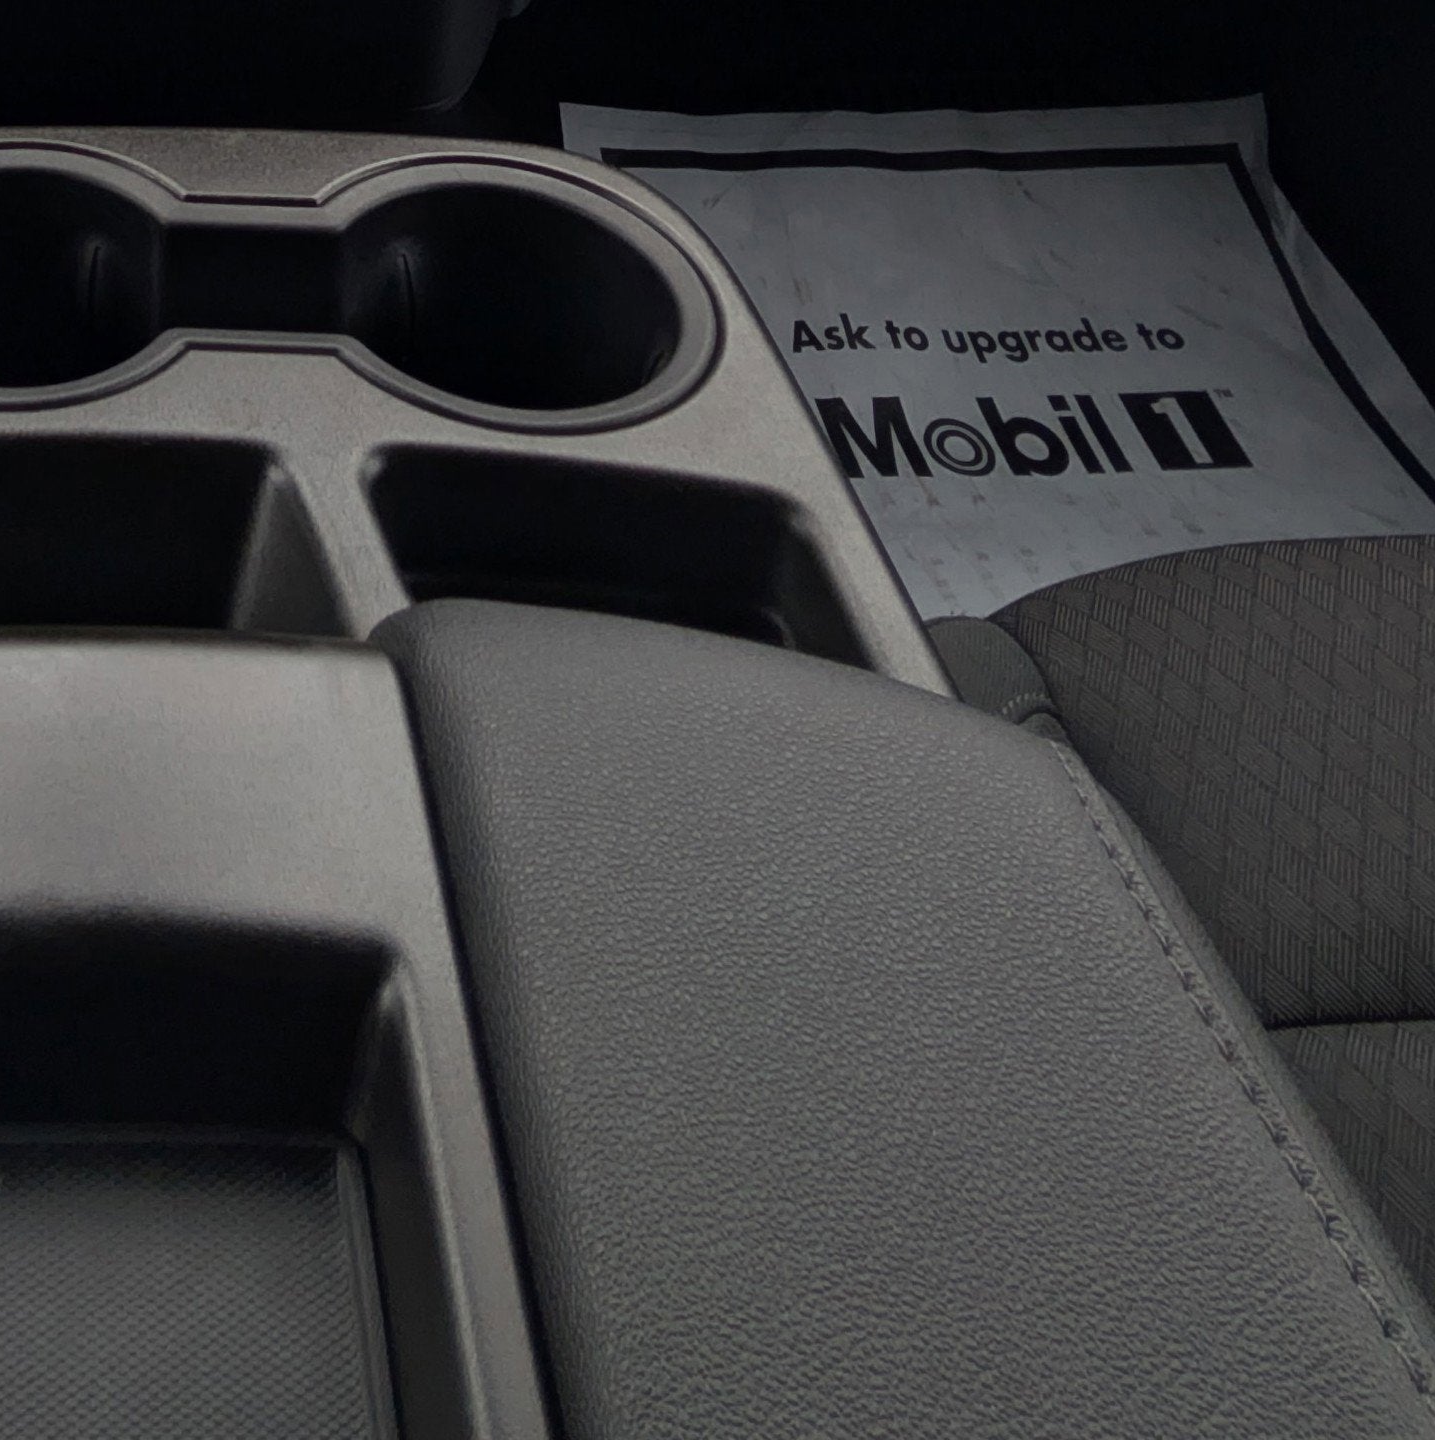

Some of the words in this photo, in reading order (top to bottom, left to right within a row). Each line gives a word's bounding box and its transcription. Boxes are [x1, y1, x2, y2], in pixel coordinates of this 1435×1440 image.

[791, 313, 875, 355] Ask
[885, 317, 930, 355] to
[942, 318, 1129, 364] upgrade
[1137, 320, 1186, 354] to
[814, 392, 1131, 479] Mobil
[1118, 389, 1255, 472] 1
